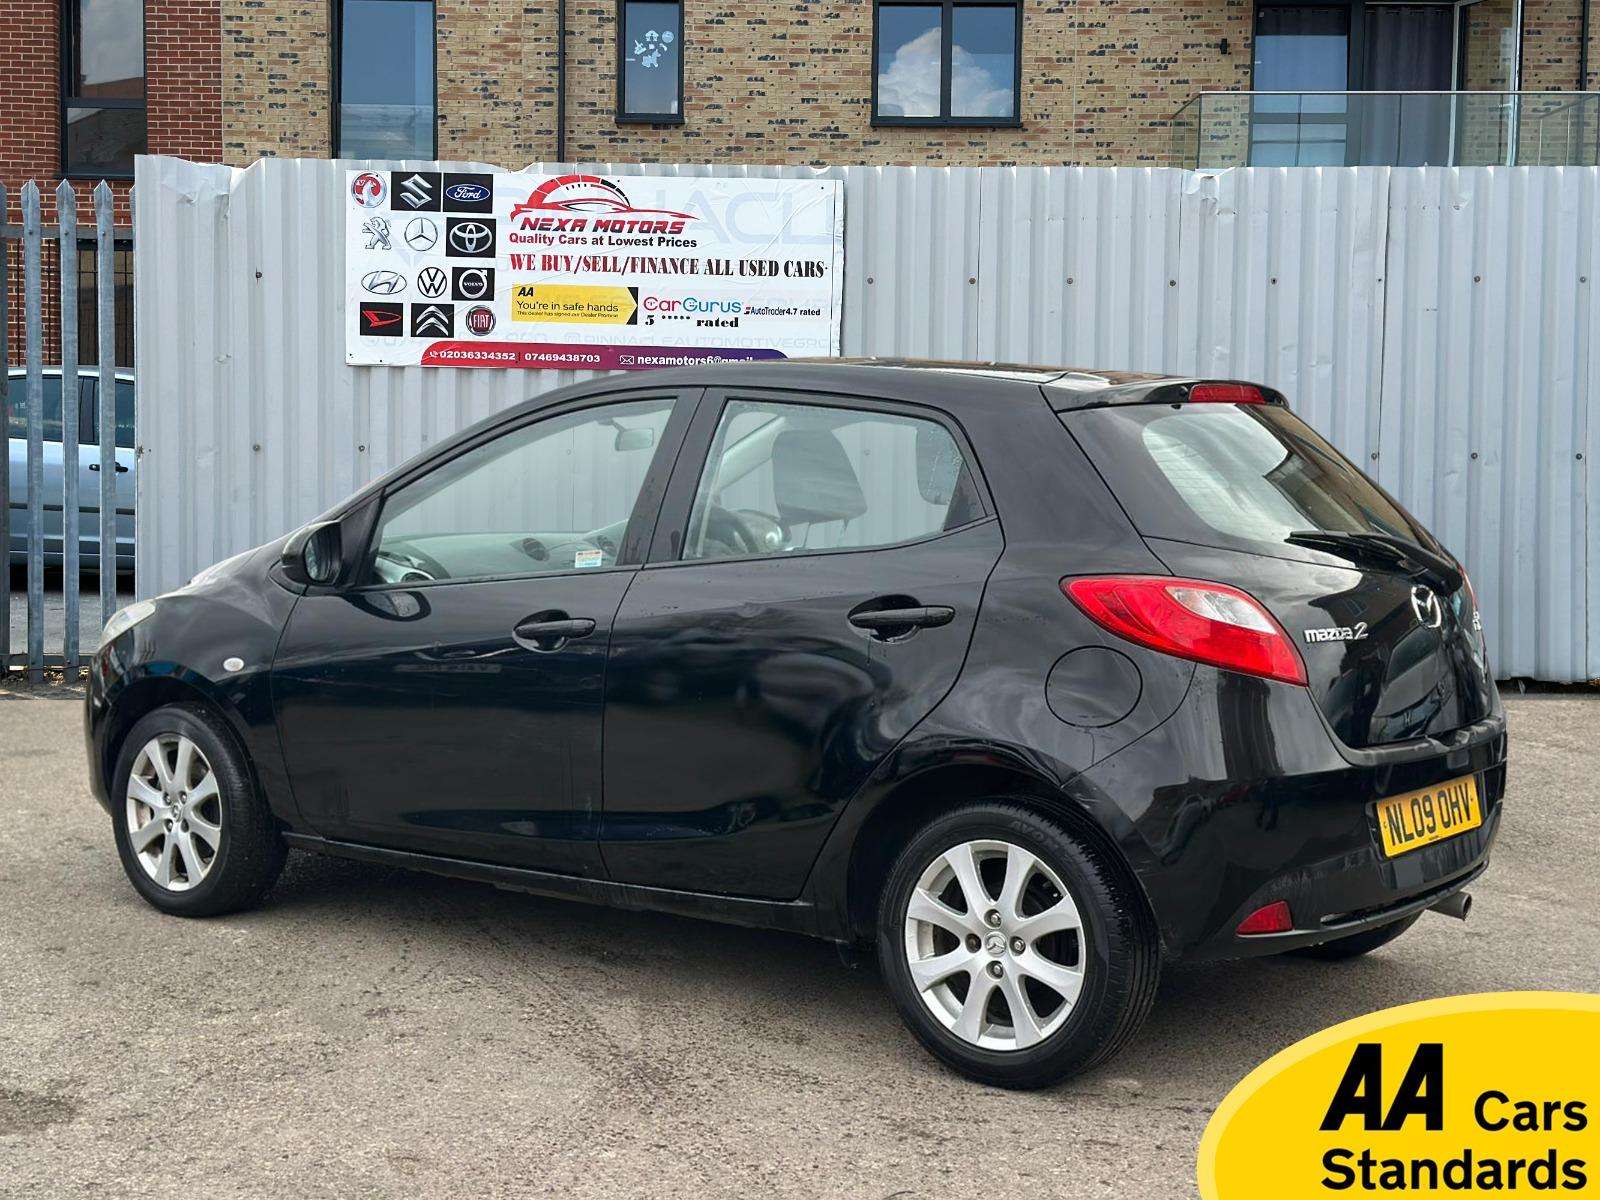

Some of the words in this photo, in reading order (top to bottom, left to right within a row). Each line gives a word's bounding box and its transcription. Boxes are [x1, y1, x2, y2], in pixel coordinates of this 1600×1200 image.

[454, 187, 482, 198] Ford
[520, 217, 588, 232] NEXA
[592, 219, 686, 235] MOTORS
[509, 232, 554, 246] Quality
[559, 234, 588, 245] Cars
[591, 235, 604, 246] at
[608, 235, 653, 247] Lowest
[658, 236, 697, 248] Prices
[509, 253, 536, 271] WE
[704, 258, 734, 276] ALL
[739, 259, 779, 277] USED
[784, 260, 825, 278] CARS
[517, 286, 534, 297] AA
[516, 300, 549, 310] You're
[551, 301, 560, 310] in
[563, 302, 584, 311] safe
[587, 303, 619, 312] hands
[643, 296, 742, 313] CarGurus
[800, 308, 821, 316] rated
[473, 314, 490, 328] FIAT
[645, 314, 655, 326] 5
[696, 317, 739, 328] rated
[440, 350, 516, 360] 02036334352
[525, 353, 601, 363] 07469438703
[1386, 794, 1436, 846] NL09
[1438, 782, 1471, 829] OHV
